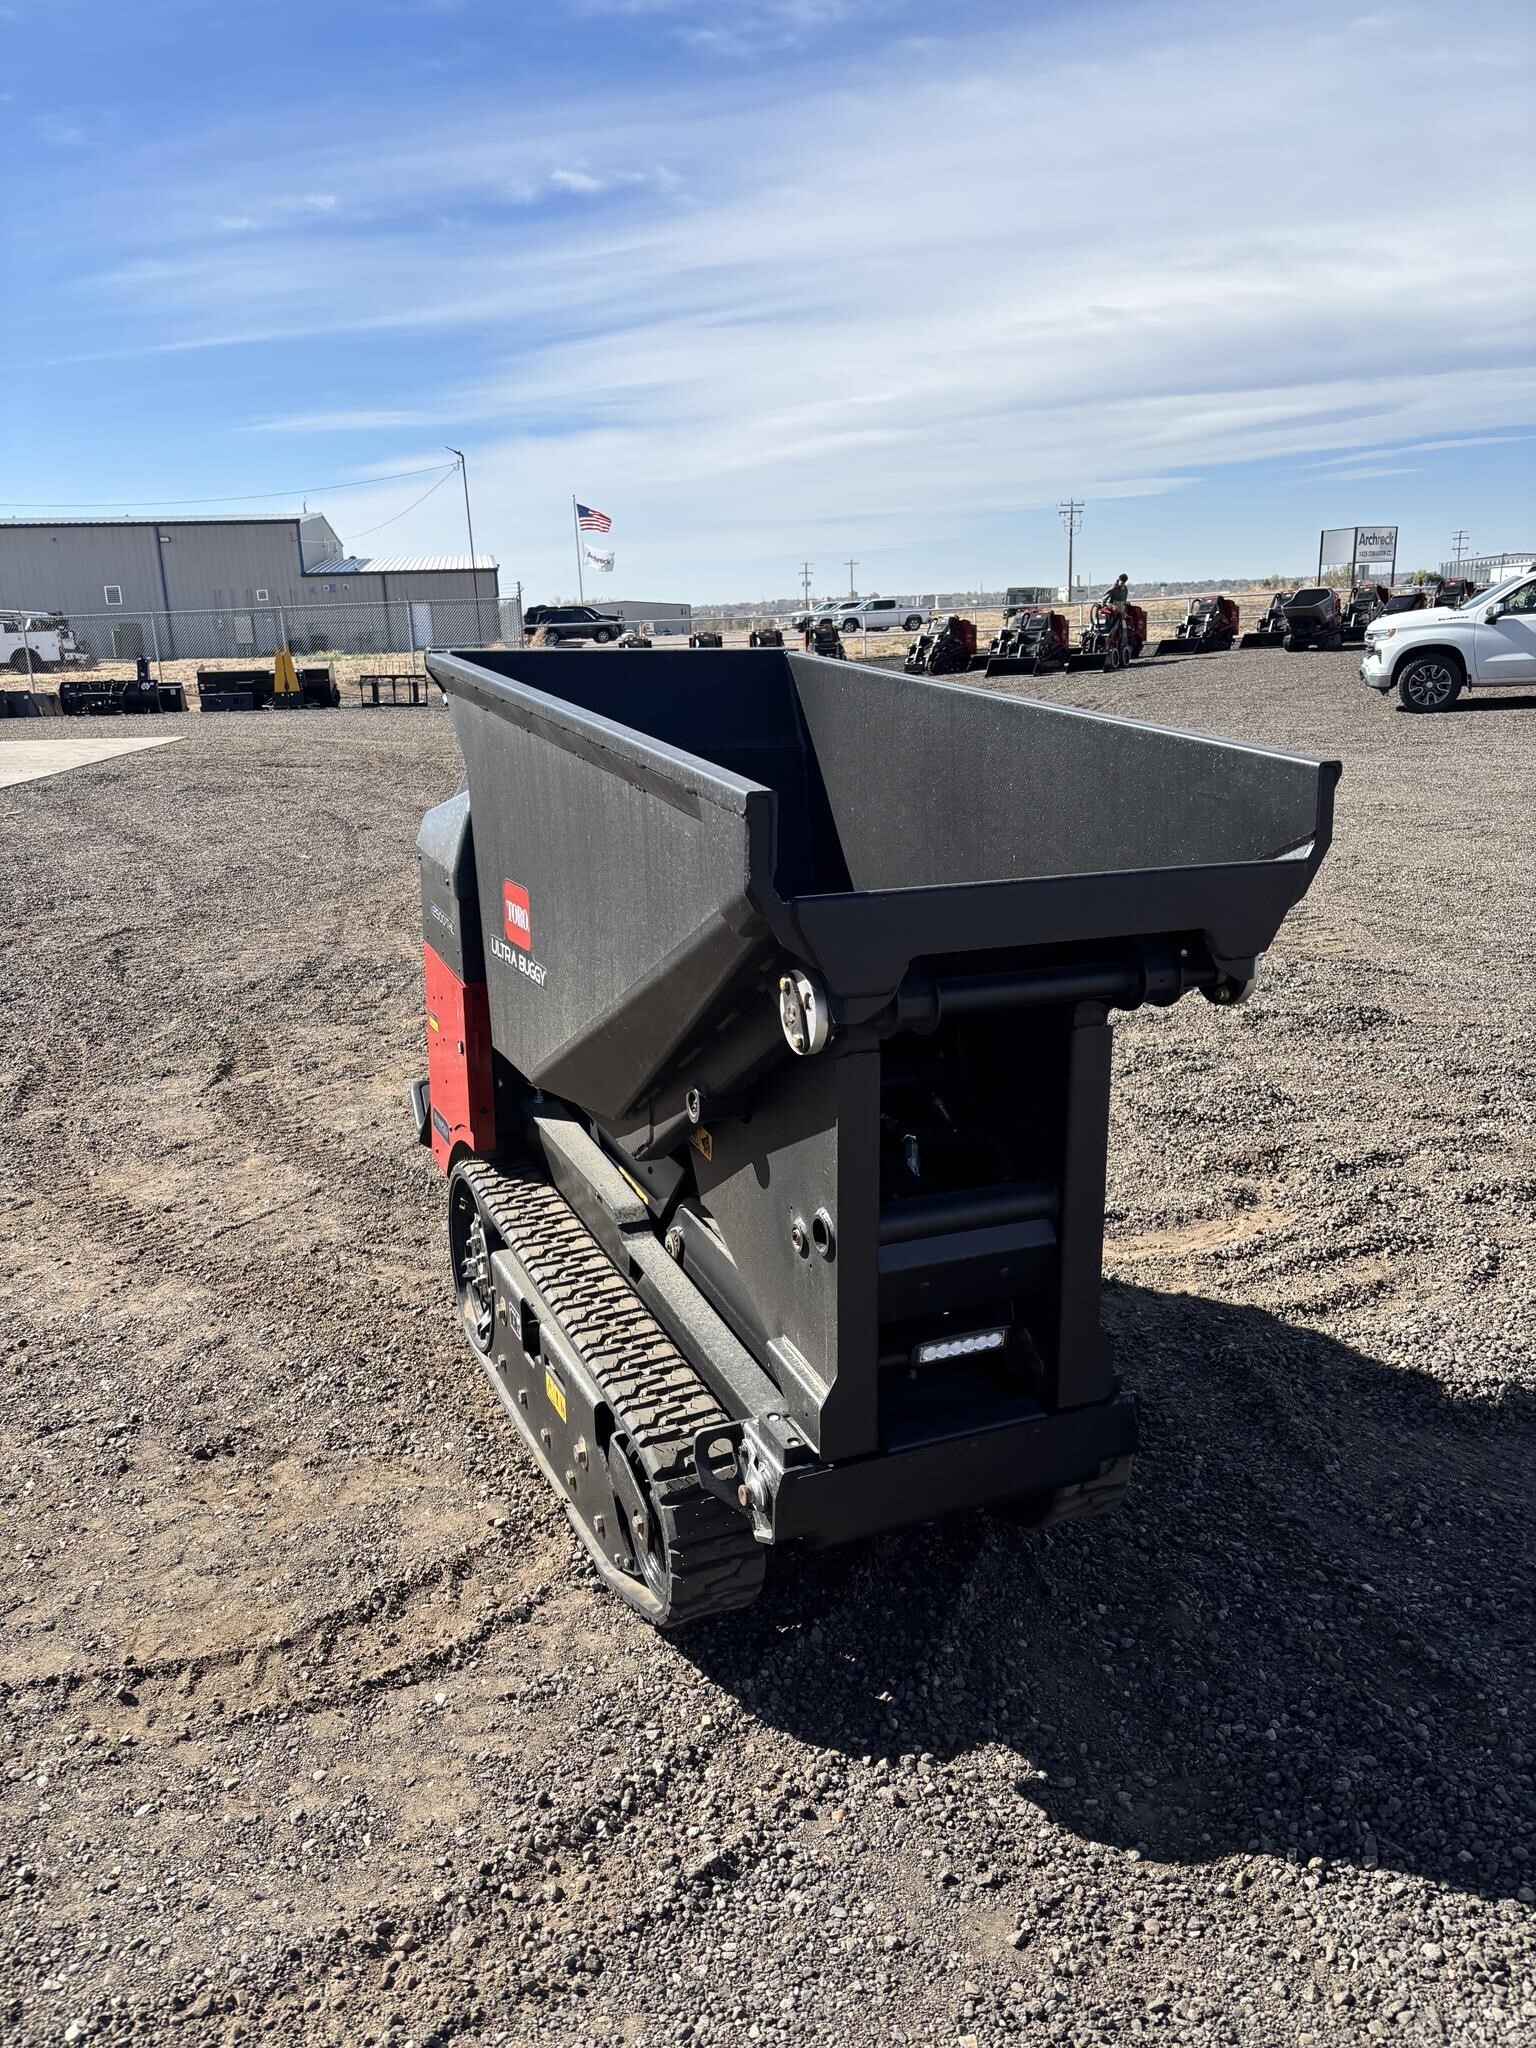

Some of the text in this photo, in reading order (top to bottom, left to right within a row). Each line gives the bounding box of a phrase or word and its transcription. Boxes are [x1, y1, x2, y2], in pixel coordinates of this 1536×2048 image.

[506, 900, 530, 932] TORO
[491, 937, 546, 987] ULTRA BUGGY
